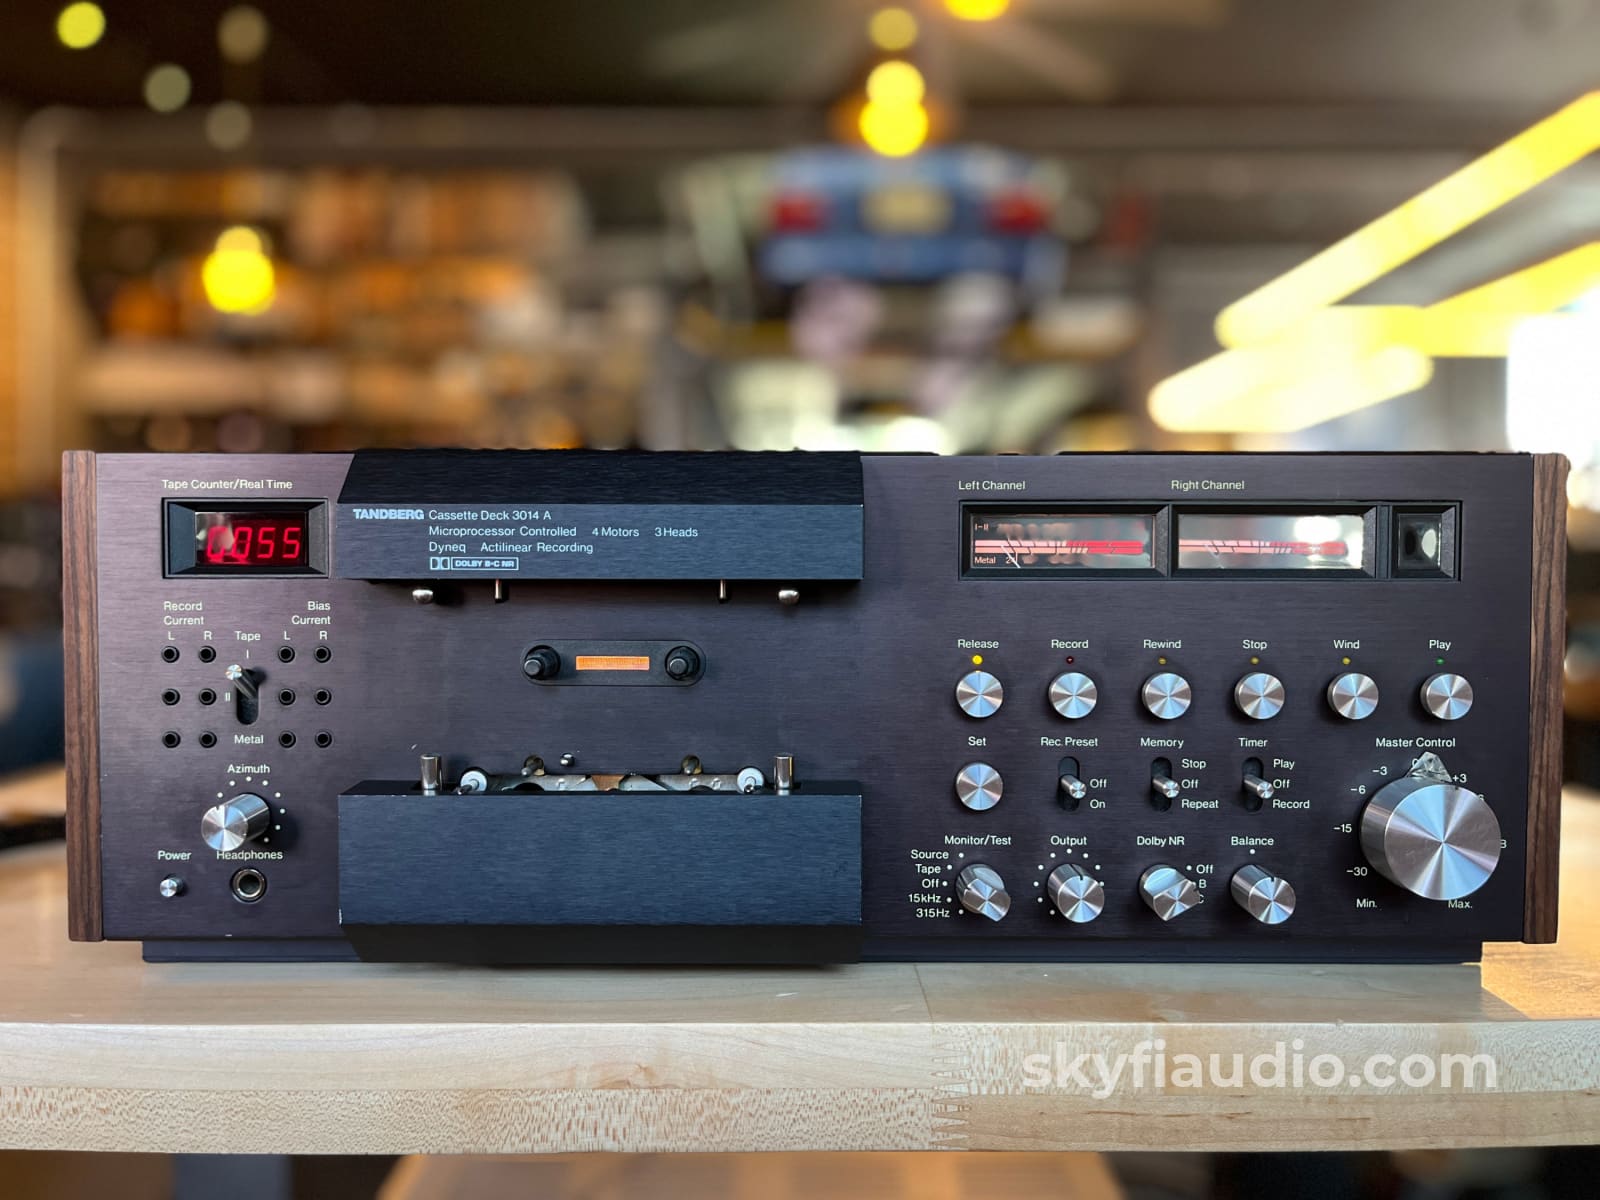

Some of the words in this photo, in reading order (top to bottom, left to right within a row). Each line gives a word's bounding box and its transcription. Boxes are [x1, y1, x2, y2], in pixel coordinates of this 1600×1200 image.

[161, 480, 188, 490] Tape
[191, 479, 264, 490] Counter/Real
[266, 480, 293, 490] Time
[958, 480, 980, 490] Left
[982, 480, 1026, 490] Channel
[1171, 480, 1199, 492] Right
[1202, 480, 1245, 490] Channel
[353, 508, 425, 520] TANDBERG
[428, 510, 478, 521] Cassette
[480, 510, 510, 521] Deck
[512, 510, 539, 520] 3014
[543, 510, 552, 520] A
[428, 526, 515, 538] Microprocessor
[520, 526, 577, 537] Controlled
[592, 527, 599, 538] 4
[601, 527, 640, 538] Motors
[654, 527, 662, 538] 3
[663, 527, 698, 538] Heads
[428, 542, 466, 554] Dyneq
[480, 542, 532, 552] Actilinear
[537, 542, 594, 554] Recording
[455, 560, 482, 568] DOLBY
[501, 560, 515, 568] NR
[974, 556, 996, 564] Metal
[164, 601, 203, 610] Record
[307, 601, 331, 611] Bias
[164, 616, 204, 626] Current
[292, 616, 331, 626] Current
[168, 631, 175, 640] L
[204, 631, 212, 640] R
[234, 631, 261, 642] Tape
[284, 631, 291, 640] L
[319, 631, 328, 640] R
[958, 640, 999, 649] Release
[1051, 640, 1089, 649] Record
[1143, 640, 1182, 649] Rewind
[1242, 640, 1268, 650] Stop
[1333, 640, 1360, 650] Wind
[1429, 640, 1452, 650] Play
[234, 734, 264, 744] Metal
[968, 736, 986, 746] Set
[1064, 737, 1098, 747] Preset
[1140, 738, 1184, 750] Memory
[1238, 737, 1268, 748] Timer
[1376, 738, 1413, 748] Master
[1416, 738, 1456, 748] Control
[227, 764, 270, 774] Azimuth
[1181, 759, 1207, 770] Stop
[1273, 759, 1296, 770] Play
[1372, 766, 1388, 776] -3
[1090, 779, 1108, 788] Off
[1181, 779, 1200, 788] Off
[1272, 779, 1290, 788] Off
[1452, 774, 1467, 783] +3
[1350, 786, 1366, 794] -6
[1090, 800, 1106, 808] On
[1181, 800, 1219, 810] Repeat
[1272, 800, 1310, 809] Record
[1333, 824, 1352, 834] -15
[944, 836, 1012, 846] Monitor/Test
[1050, 836, 1087, 847] Output
[1136, 836, 1167, 848] Dolby
[1168, 836, 1185, 846] NR
[1231, 836, 1274, 846] Balance
[158, 850, 192, 860] Power
[216, 850, 283, 861] Headphones
[910, 850, 949, 860] Source
[915, 864, 941, 875] Tape
[1196, 864, 1214, 874] Off
[1346, 867, 1368, 876] -30
[922, 879, 940, 888] Off
[1198, 880, 1207, 889] B
[908, 894, 942, 904] 15kHz
[1356, 898, 1378, 908] Min.
[1448, 900, 1473, 909] Max.
[916, 908, 950, 918] 315Hz
